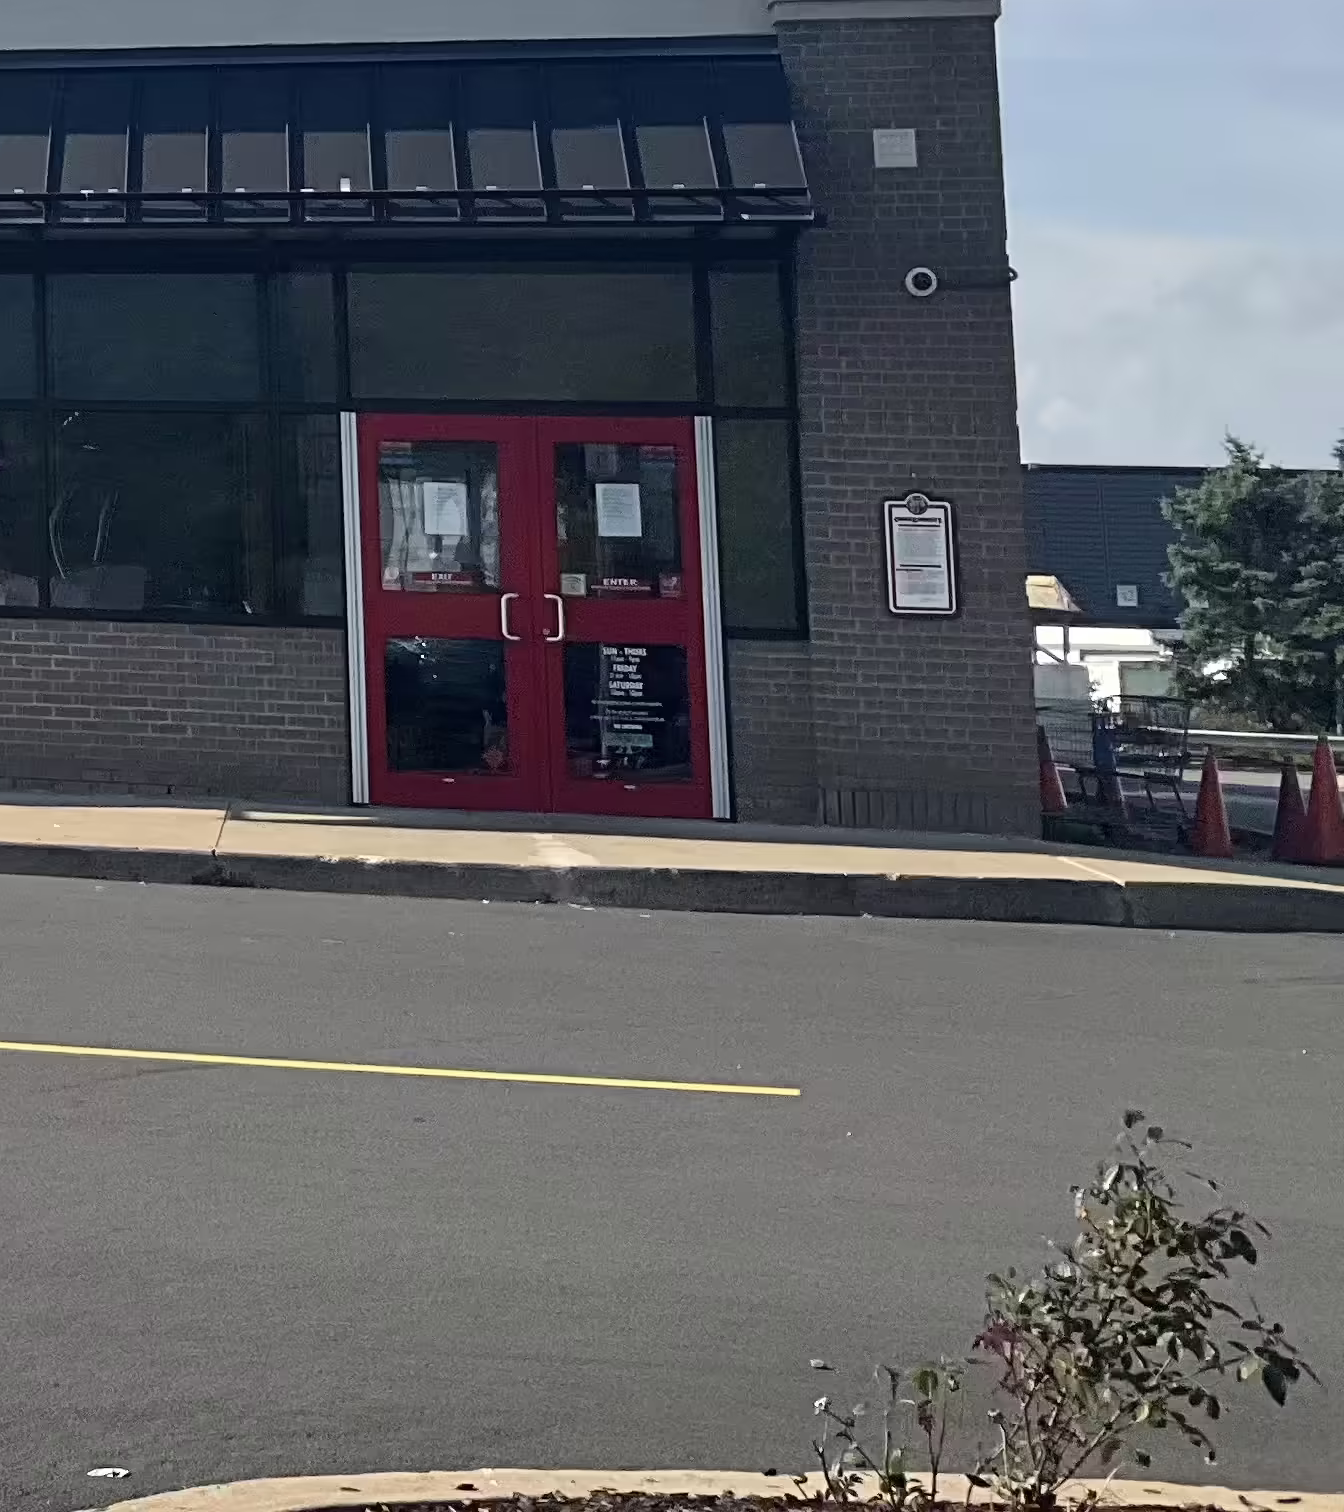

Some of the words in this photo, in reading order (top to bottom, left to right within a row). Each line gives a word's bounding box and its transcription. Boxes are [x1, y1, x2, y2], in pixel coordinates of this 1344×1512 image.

[431, 572, 453, 581] EXIT
[602, 577, 638, 587] ENTER
[613, 664, 638, 672] FRIDAY
[609, 681, 643, 689] SATURDAY
